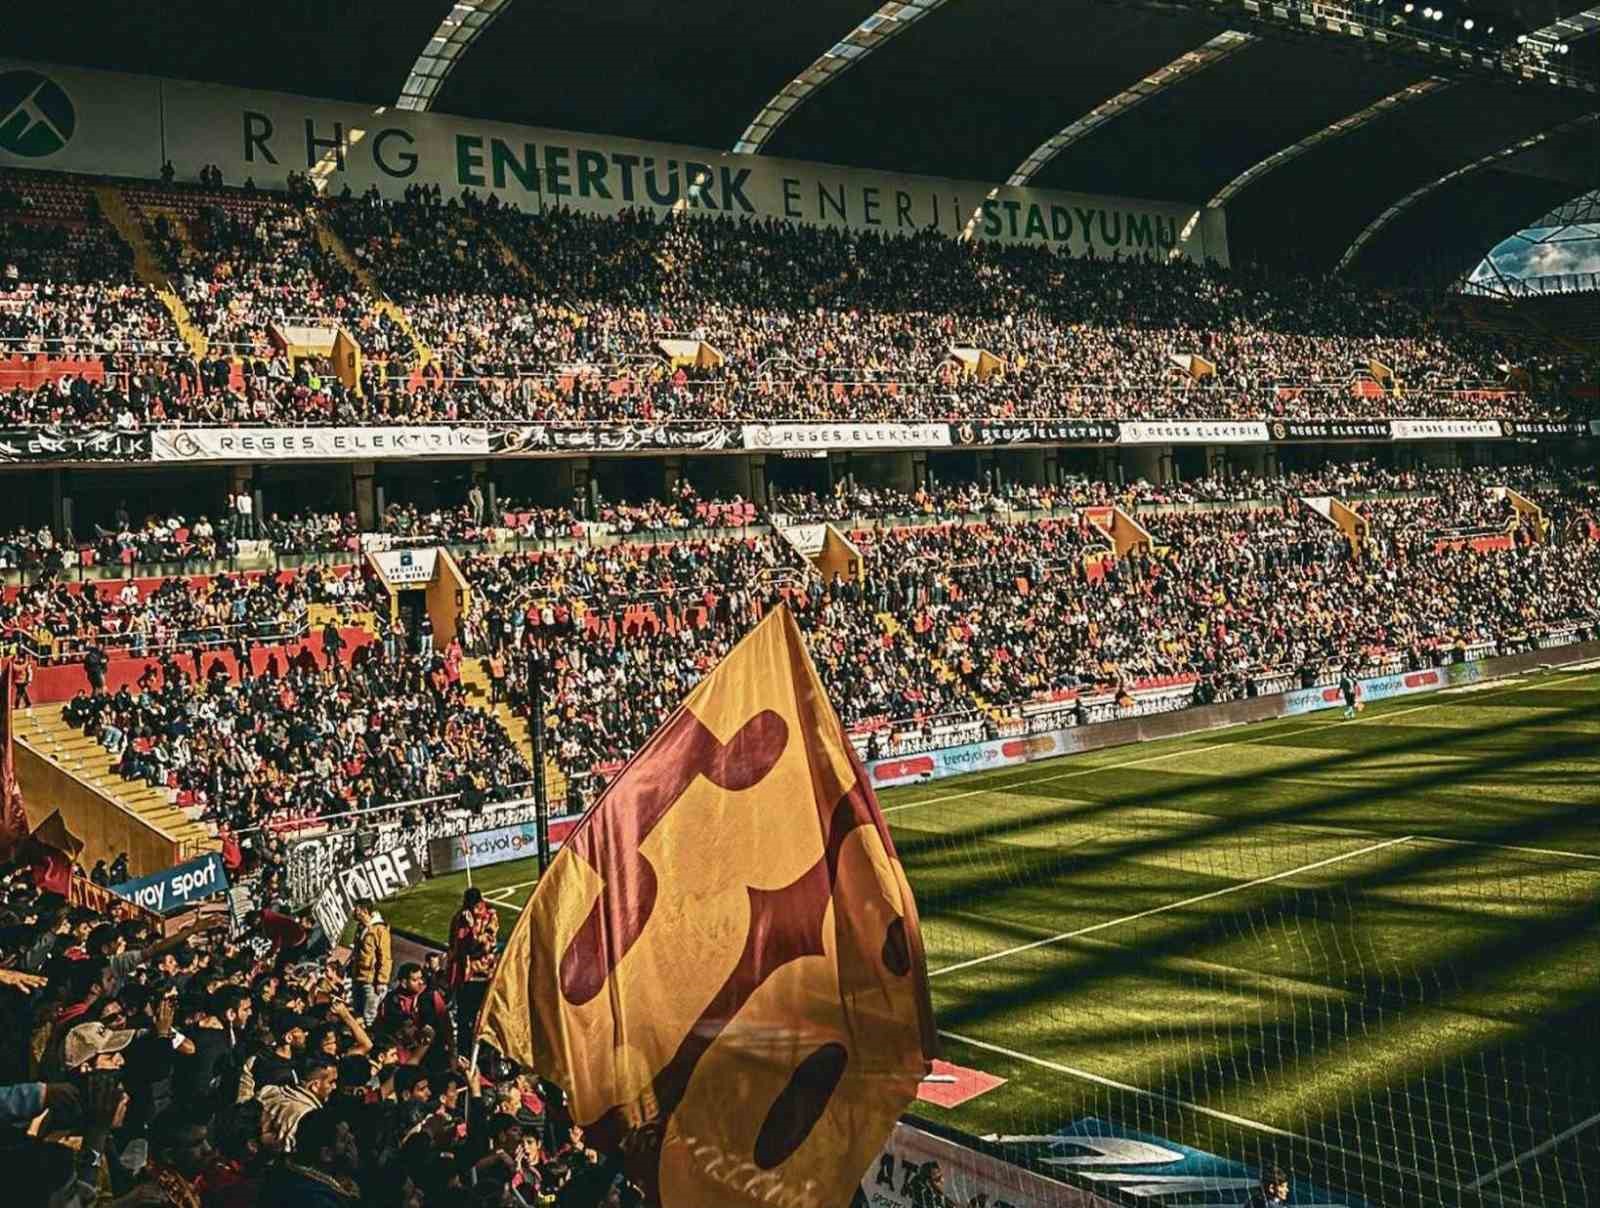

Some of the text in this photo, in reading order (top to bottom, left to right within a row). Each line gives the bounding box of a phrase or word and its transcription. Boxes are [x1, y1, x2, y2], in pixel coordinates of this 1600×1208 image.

[455, 133, 755, 213] ENERTÜRK
[982, 198, 1177, 249] STADYUMU
[220, 436, 315, 449] REGES
[784, 431, 841, 441] REGES
[171, 856, 217, 900] sport
